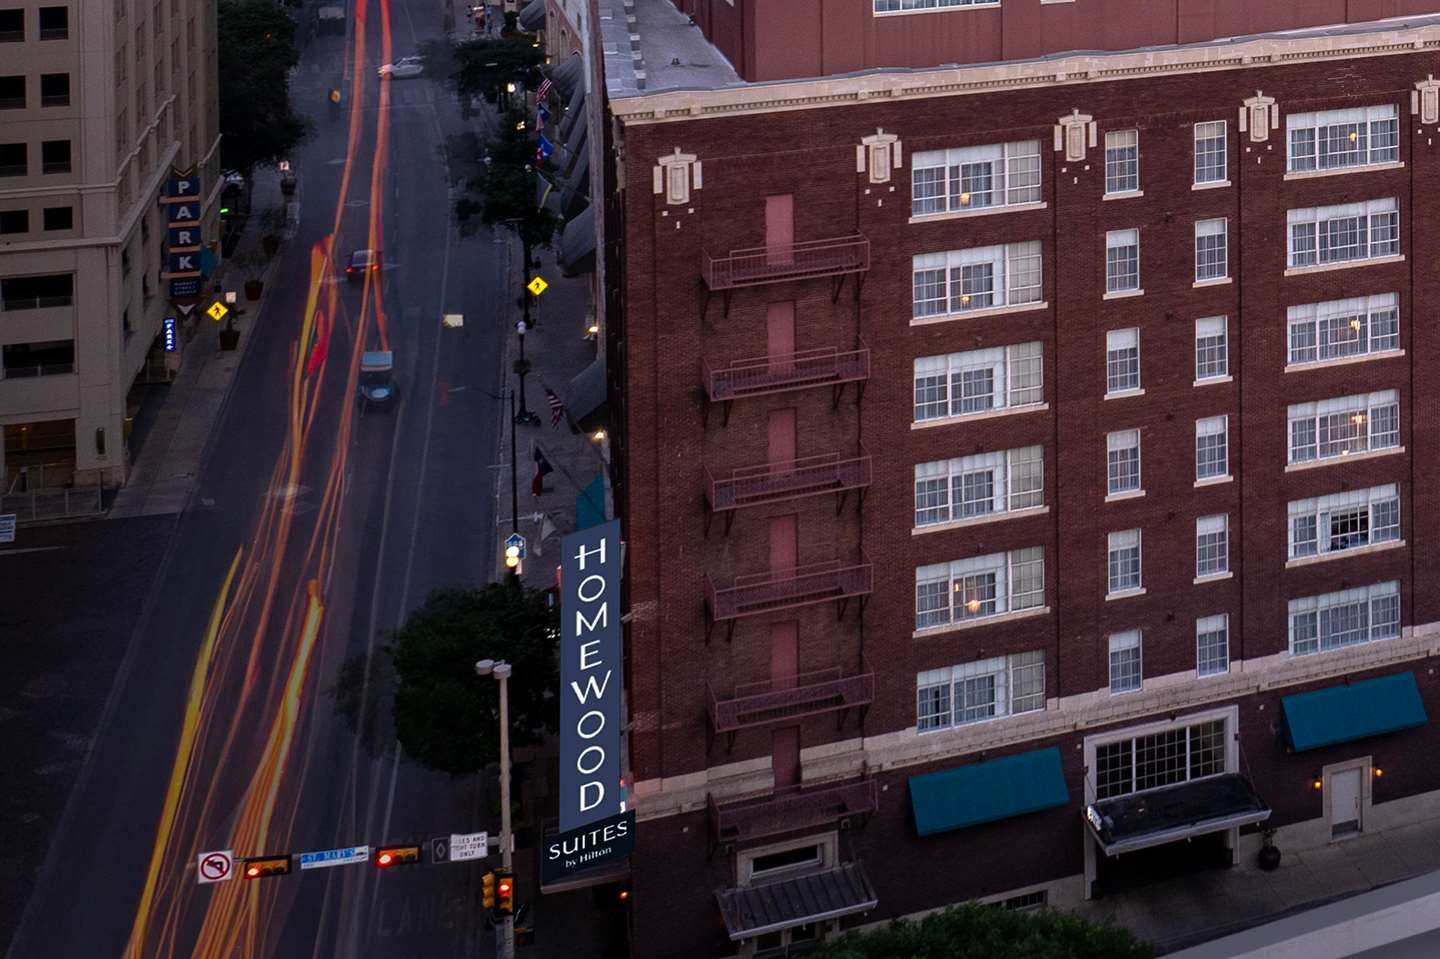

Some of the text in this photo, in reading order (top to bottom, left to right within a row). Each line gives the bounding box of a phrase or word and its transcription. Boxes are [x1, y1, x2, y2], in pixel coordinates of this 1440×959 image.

[176, 181, 193, 270] PARK
[570, 538, 612, 812] HOMEWOOD
[549, 820, 627, 860] SUITES
[565, 847, 612, 868] by Hilton
